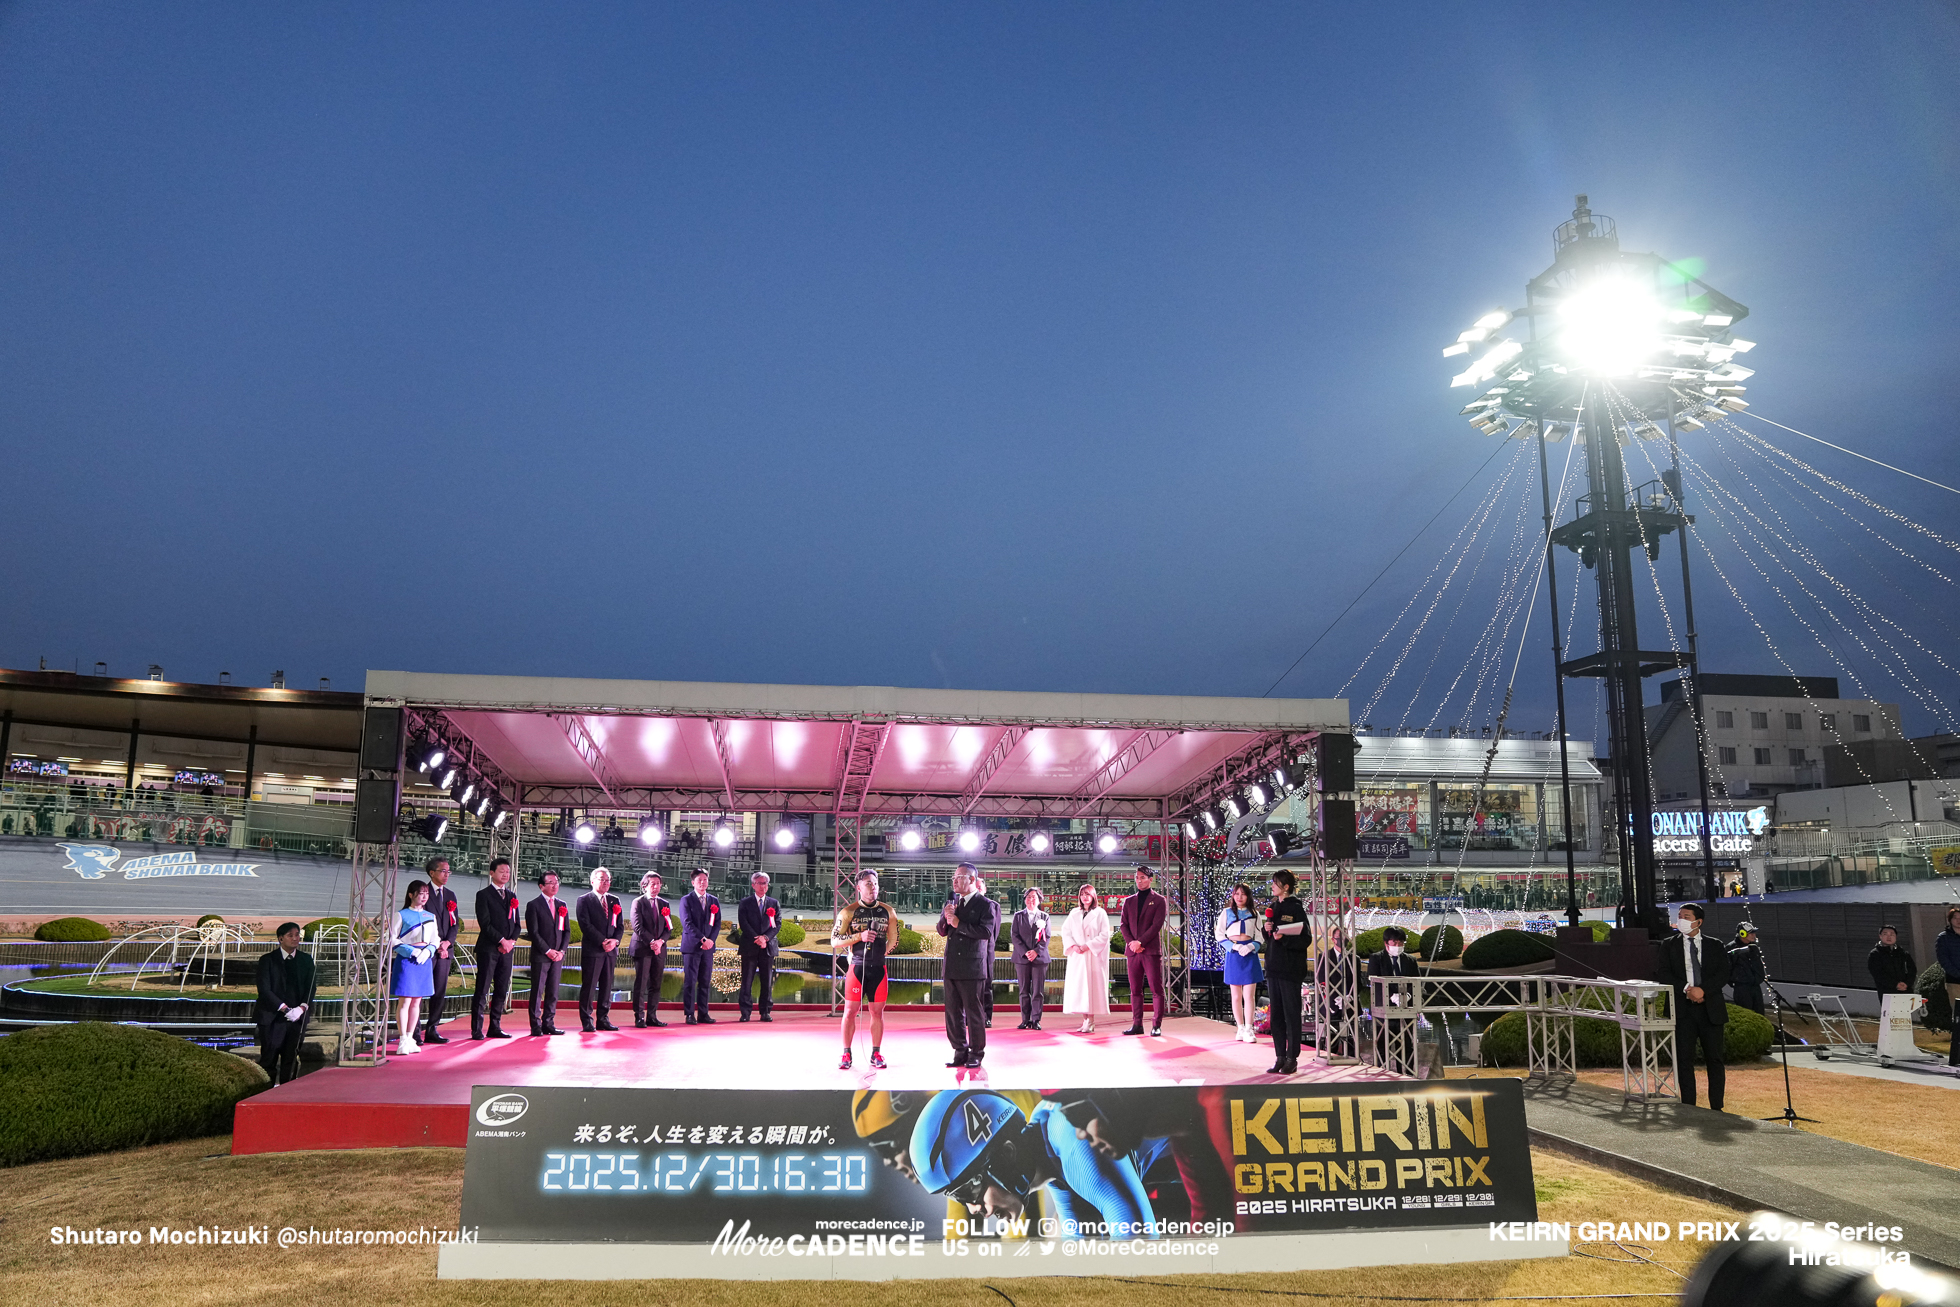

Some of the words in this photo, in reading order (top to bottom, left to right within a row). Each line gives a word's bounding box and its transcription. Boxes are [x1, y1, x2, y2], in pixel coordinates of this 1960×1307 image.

[1652, 837, 1700, 852] acers'
[1711, 836, 1752, 852] Gate
[124, 852, 194, 869] ABEMA
[127, 865, 197, 879] SHONAN
[199, 864, 252, 876] BANK
[1889, 1017, 1912, 1025] KEIRIN
[963, 1098, 993, 1147] 4
[1230, 1095, 1489, 1156] KEIRIN
[573, 1123, 837, 1146] 来るぞ、人生を変える瞬間が。
[1234, 1159, 1388, 1194] GRAND
[1395, 1156, 1493, 1189] PRIX
[1236, 1200, 1287, 1215] 2025
[1292, 1196, 1397, 1214] HIRATSUKA
